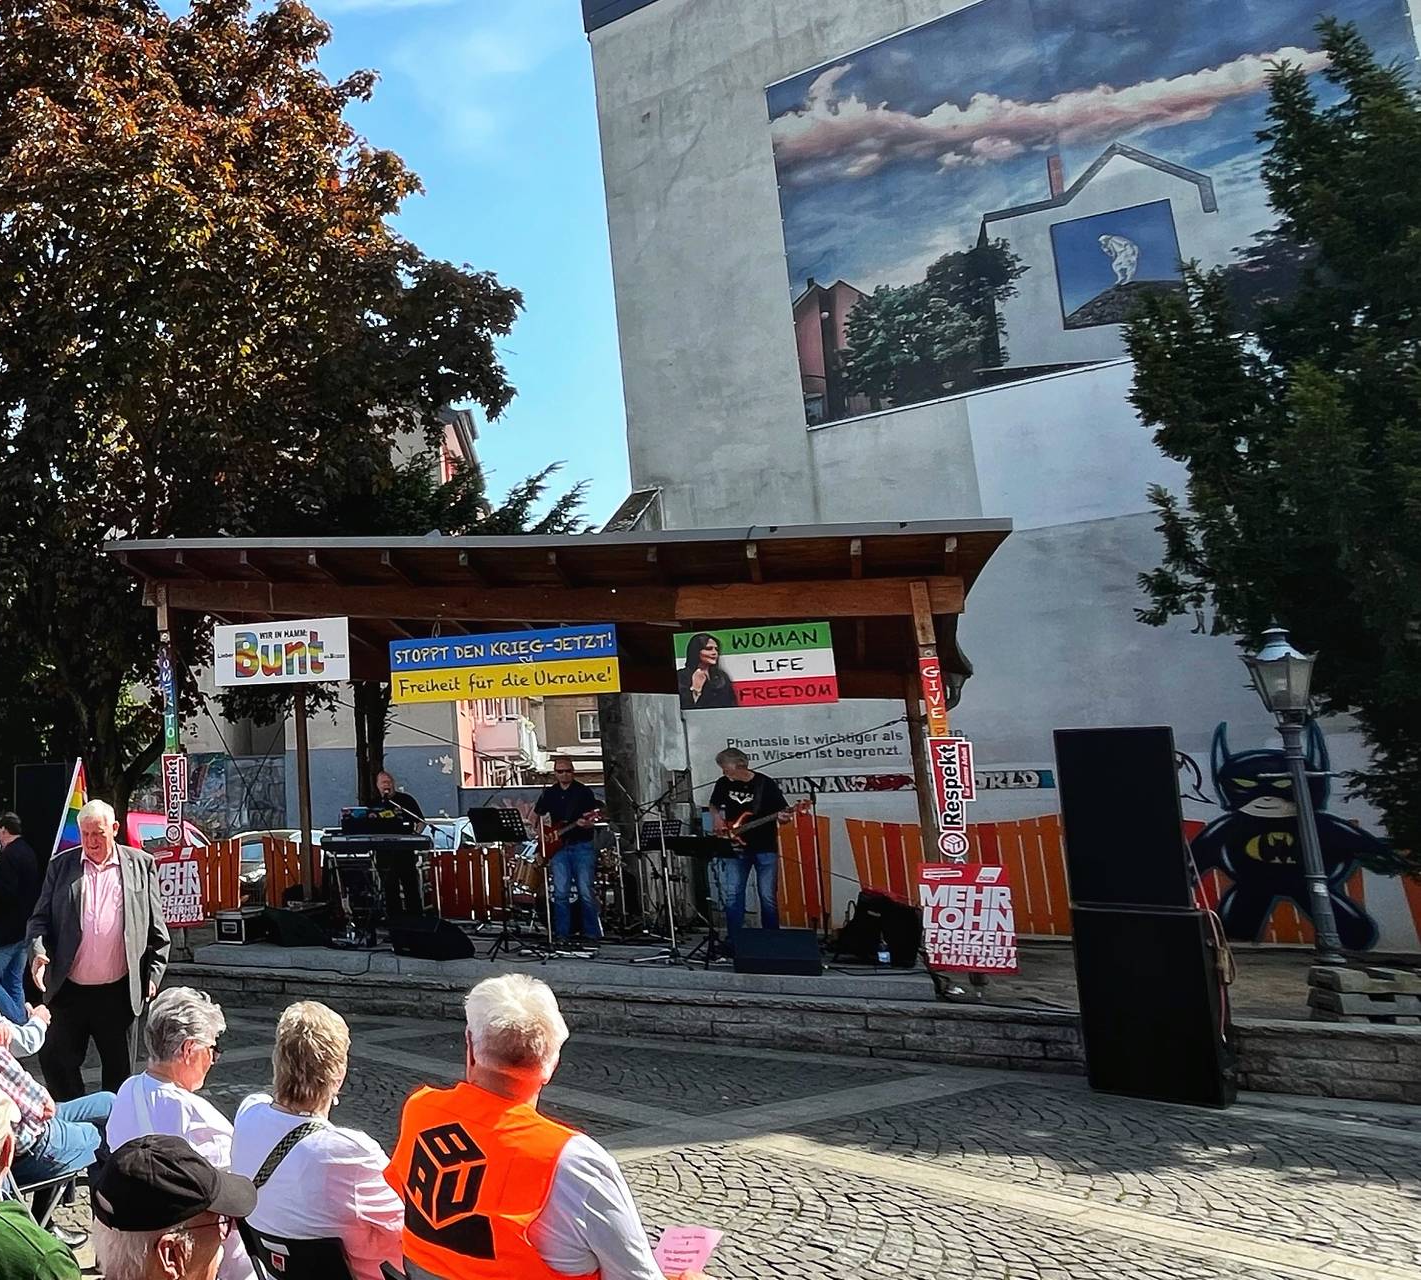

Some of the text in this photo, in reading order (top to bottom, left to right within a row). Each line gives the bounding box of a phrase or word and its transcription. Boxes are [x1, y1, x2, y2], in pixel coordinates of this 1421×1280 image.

[259, 631, 273, 640] WIR
[732, 628, 817, 649] WOMAN
[235, 631, 325, 678] Bunt
[394, 645, 449, 665] STOPPT
[454, 643, 484, 659] DEN
[752, 657, 804, 673] LIFE
[399, 665, 612, 697] Freiheit für die Ukraine!
[738, 684, 833, 701] FREEDOM
[922, 665, 944, 719] GIVE
[726, 729, 904, 748] Phantasie ist wichtiger als
[762, 749, 811, 762] Wissen
[815, 748, 832, 759] ist
[836, 746, 903, 759] begrenzt.
[975, 770, 1040, 788] ORLD
[160, 877, 201, 896] OHN
[161, 894, 202, 907] REIZEIT
[918, 884, 1013, 909] MEHR
[162, 905, 203, 915] CHERHEIT
[923, 906, 1015, 932] LOHN
[924, 928, 1016, 946] FREIZEIT
[925, 943, 1017, 957] SICHERHEIT
[929, 953, 1017, 969] 1. MAI 2024
